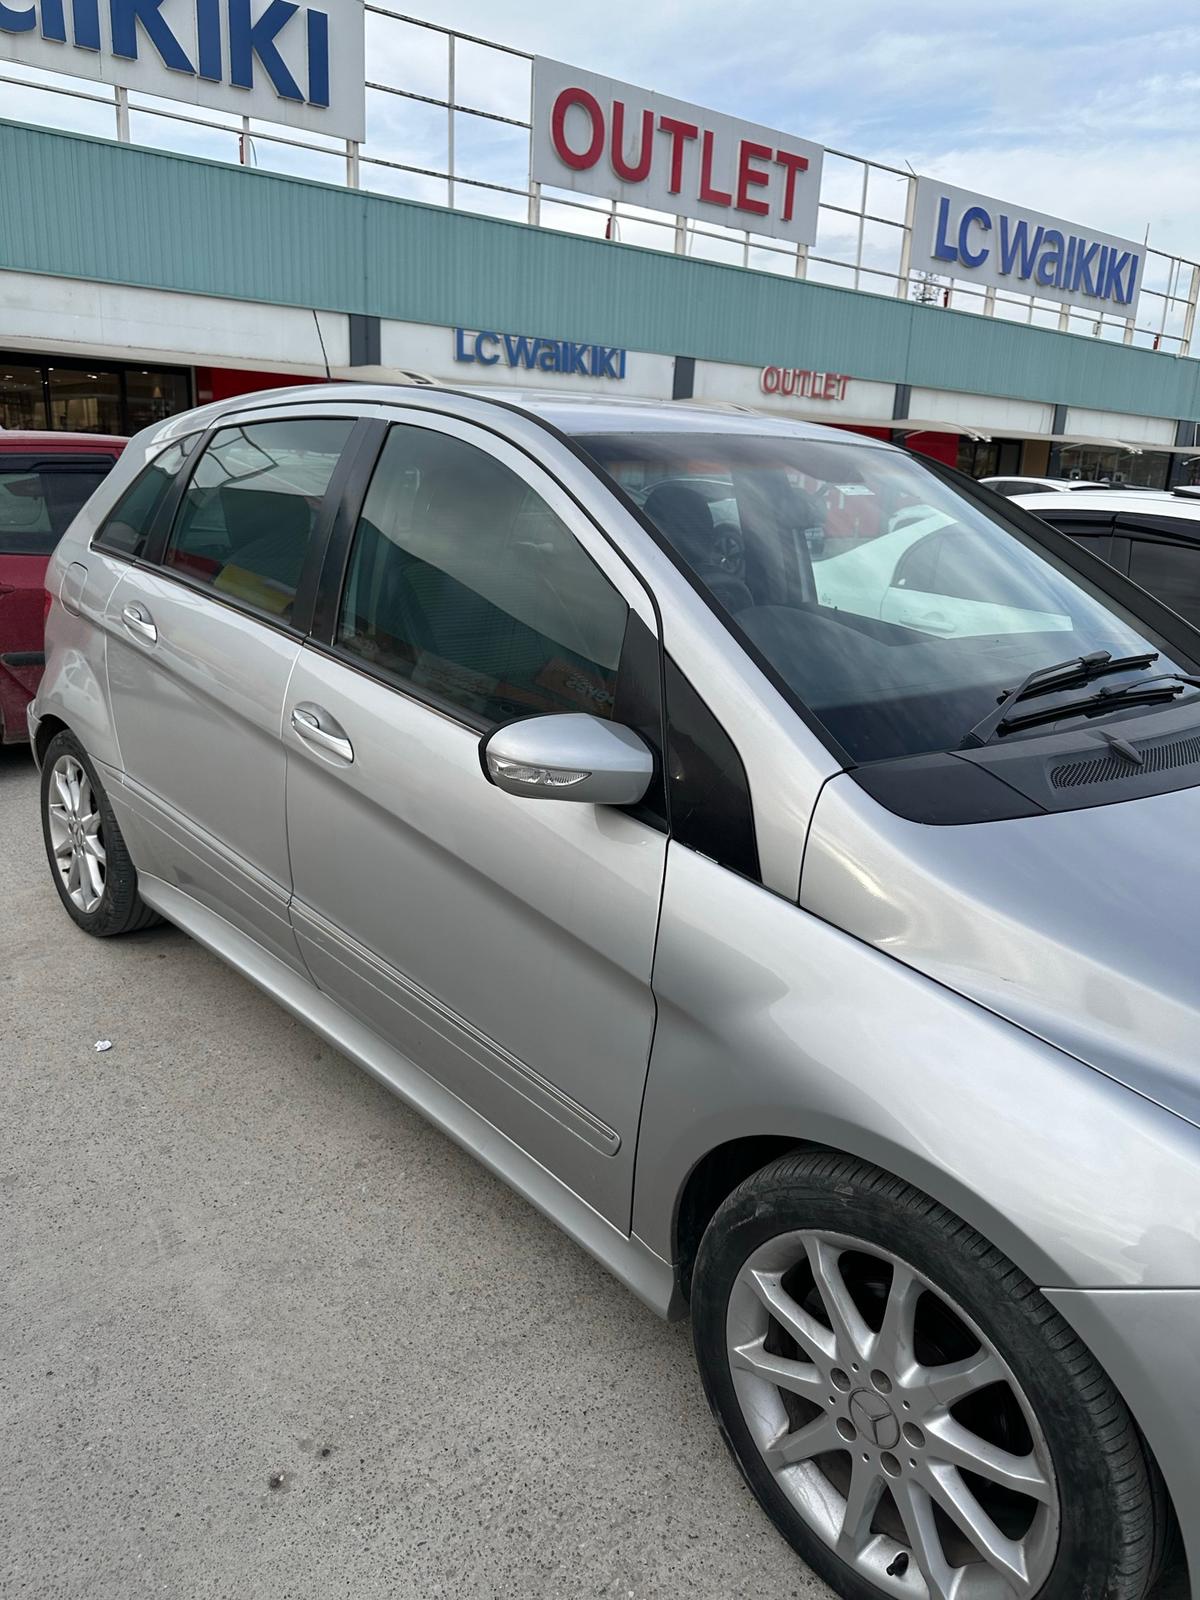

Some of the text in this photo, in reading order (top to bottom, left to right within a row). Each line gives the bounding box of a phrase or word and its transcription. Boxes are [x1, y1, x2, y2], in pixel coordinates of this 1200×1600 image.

[551, 87, 809, 221] OUTLET
[931, 197, 992, 268] LC
[454, 328, 500, 366] LC
[761, 366, 848, 400] OUTLET
